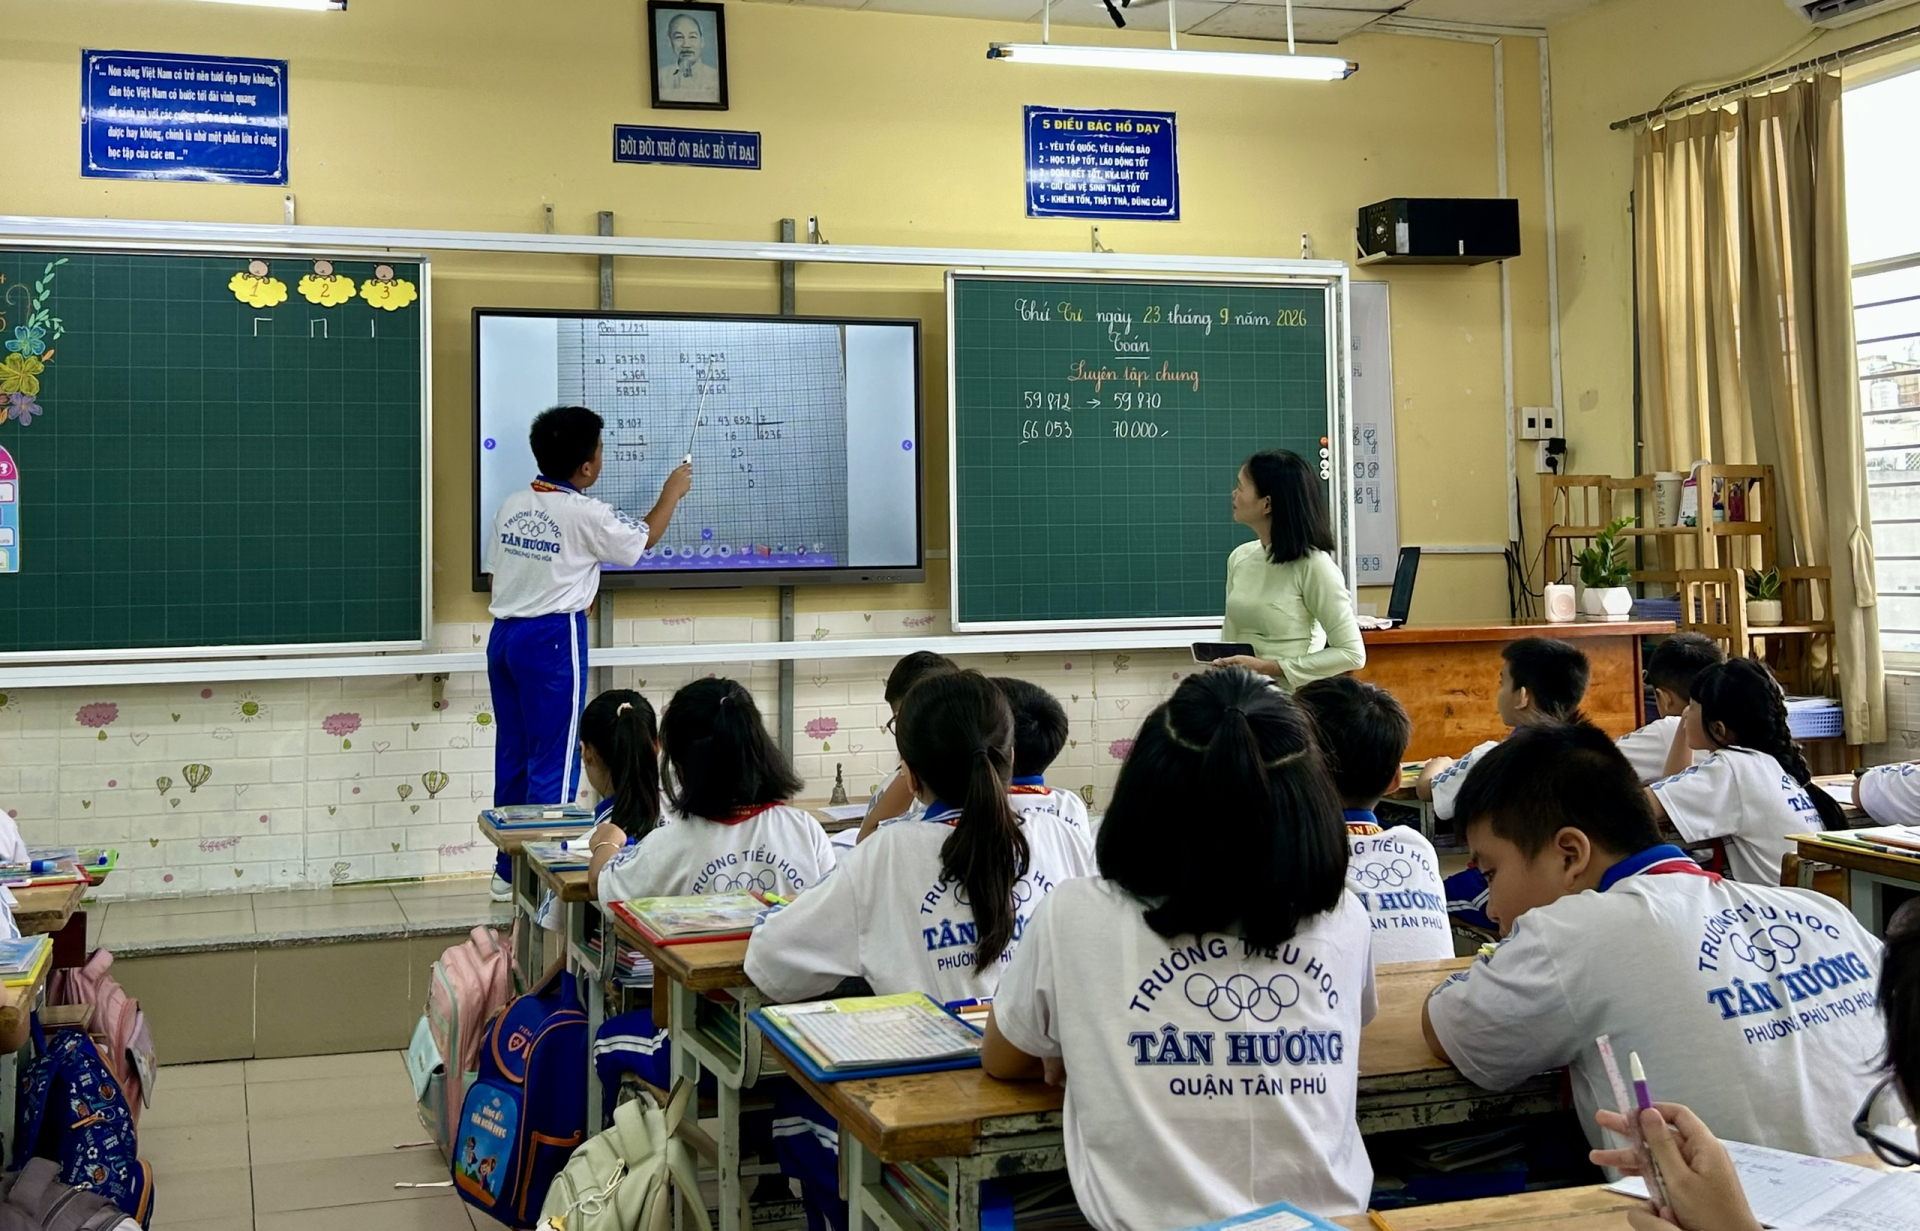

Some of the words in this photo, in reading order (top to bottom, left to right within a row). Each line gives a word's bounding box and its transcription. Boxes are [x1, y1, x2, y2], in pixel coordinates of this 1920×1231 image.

[108, 64, 122, 77] Non
[123, 67, 140, 80] sông
[142, 66, 155, 79] Việt
[157, 68, 172, 80] Nam
[174, 69, 182, 80] có
[184, 69, 195, 81] trở
[225, 71, 238, 85] đẹp
[239, 72, 250, 85] hay
[109, 85, 122, 97] dân
[123, 87, 135, 100] tộc
[136, 86, 150, 99] Việt
[152, 88, 167, 99] Nam
[168, 88, 177, 100] có
[179, 89, 195, 101] bước
[220, 91, 234, 102] vinh
[236, 94, 256, 106] quang
[1043, 119, 1050, 129] 5
[1054, 117, 1083, 130] ĐIỀU
[1087, 119, 1112, 132] BÁC
[1116, 119, 1132, 132] HỒ
[1137, 123, 1160, 135] DẠY
[108, 126, 124, 140] được
[126, 126, 138, 140] hay
[186, 128, 192, 141] là
[208, 130, 222, 145] một
[223, 130, 240, 145] phần
[242, 132, 252, 144] lớn
[260, 134, 277, 148] công
[1039, 142, 1043, 150] 1
[1050, 141, 1064, 151] YÊU
[1066, 139, 1075, 152] TỔ
[1077, 142, 1098, 153] QUỐC,
[1100, 143, 1114, 153] YÊU
[1115, 144, 1135, 154] ĐỒNG
[1136, 144, 1150, 154] BÀO
[108, 146, 120, 160] học
[122, 146, 134, 162] tập
[136, 146, 149, 159] của
[150, 148, 163, 160] các
[164, 151, 175, 160] em
[620, 134, 636, 156] ĐỜI
[638, 136, 655, 156] ĐỜI
[656, 137, 676, 158] NHỚ
[678, 140, 690, 158] ƠN
[692, 138, 710, 159] BÁC
[712, 136, 725, 160] HỒ
[728, 142, 737, 161] VĨ
[739, 144, 755, 164] ĐẠI
[1039, 156, 1044, 164] 2
[1050, 155, 1065, 167] HỌC
[1066, 155, 1080, 167] TẬP
[1082, 155, 1098, 166] TỐT,
[1099, 157, 1113, 166] LAO
[1114, 157, 1134, 168] ĐỘNG
[1135, 157, 1148, 168] TỐT
[1136, 170, 1149, 181] TỐT
[1039, 182, 1045, 190] 4
[1051, 182, 1063, 191] GIỮ
[1078, 182, 1087, 193] VỆ
[1089, 184, 1106, 192] SINH
[1107, 183, 1125, 195] THẬT
[1127, 182, 1140, 193] TỐT
[1051, 194, 1074, 204] KHIÊM
[1076, 194, 1092, 206] TỐN,
[1093, 196, 1112, 208] THẬT
[1131, 196, 1150, 207] DŨNG
[1152, 194, 1167, 207] CẢM
[248, 282, 259, 298] 1
[320, 282, 330, 298] 2
[380, 285, 391, 300] 3
[1014, 298, 1051, 322] Thứ
[1057, 301, 1084, 322] Tư
[1096, 308, 1133, 334] ngày
[1142, 305, 1161, 324] 23
[1167, 303, 1213, 336] tháng
[1220, 307, 1230, 326] 9
[1234, 310, 1271, 326] năm
[1276, 308, 1307, 327] 2026
[1108, 331, 1150, 352] Toán
[1124, 366, 1149, 388] tập
[1156, 360, 1199, 392] chung
[1024, 391, 1042, 409] 59
[1048, 392, 1071, 411] 872
[1113, 392, 1132, 411] 59
[1137, 392, 1161, 409] 870
[1022, 420, 1039, 439] 66
[1045, 420, 1072, 438] 053
[500, 532, 521, 547] TÂN
[522, 538, 562, 554] HƯƠNG
[1372, 834, 1404, 854] TIỂU
[691, 853, 738, 895] RƯỜNG
[742, 844, 776, 865] TIỂU
[778, 859, 804, 890] HỌC
[1390, 914, 1419, 928] TÂN
[1785, 909, 1840, 940] HỌC
[922, 918, 977, 952] TÂN
[937, 950, 979, 971] PHƯỜN
[1129, 938, 1228, 1014] TRƯỜNG
[1304, 956, 1339, 1010] HỌC
[1707, 976, 1783, 1020] TÂN
[1798, 1002, 1830, 1028] PHÚ
[1826, 998, 1857, 1018] THỌ
[1127, 1022, 1216, 1067] TÂN
[1225, 1026, 1344, 1067] HƯƠNG
[1169, 1074, 1234, 1100] QUẬN
[1240, 1074, 1284, 1096] TÂN
[1290, 1072, 1327, 1095] PHÚ
